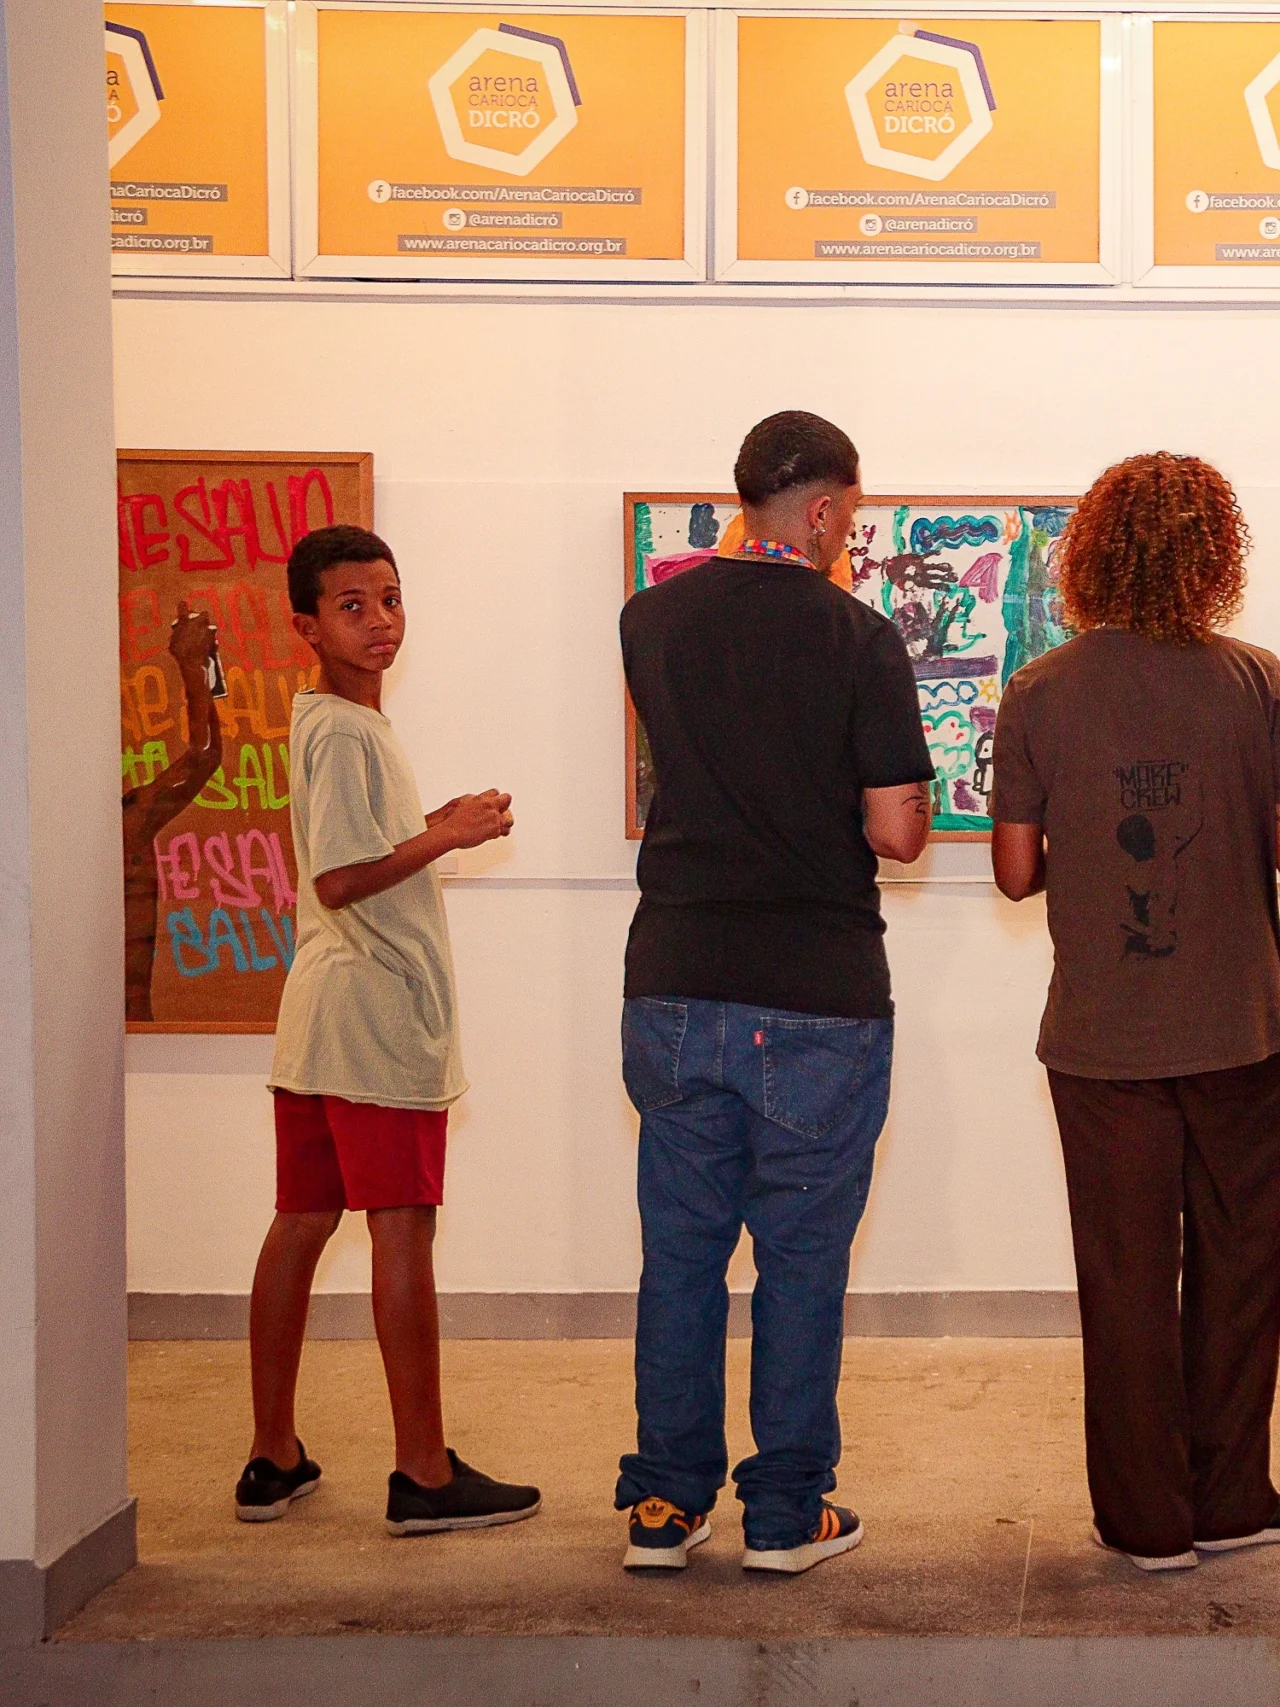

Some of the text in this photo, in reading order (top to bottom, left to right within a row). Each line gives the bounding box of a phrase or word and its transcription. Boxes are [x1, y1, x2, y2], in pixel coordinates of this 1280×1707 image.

[469, 76, 539, 92] arena
[885, 81, 954, 98] arena
[468, 95, 539, 107] CARIOCA
[884, 100, 953, 113] CARIOCA
[468, 108, 540, 128] DICRÓ
[884, 113, 956, 134] DICRÓ
[392, 186, 635, 203] facebook.com/ArenaCariocaDicró
[809, 192, 1049, 207] facebook.com/ArenaCariocaDicró
[469, 213, 558, 227] @arenadicró
[885, 218, 973, 232] @arenadicró
[404, 237, 623, 254] www.arenacariocadicro.org.br
[821, 242, 1037, 258] www.arenacariocadicro.org.br
[1120, 786, 1181, 810] CREW
